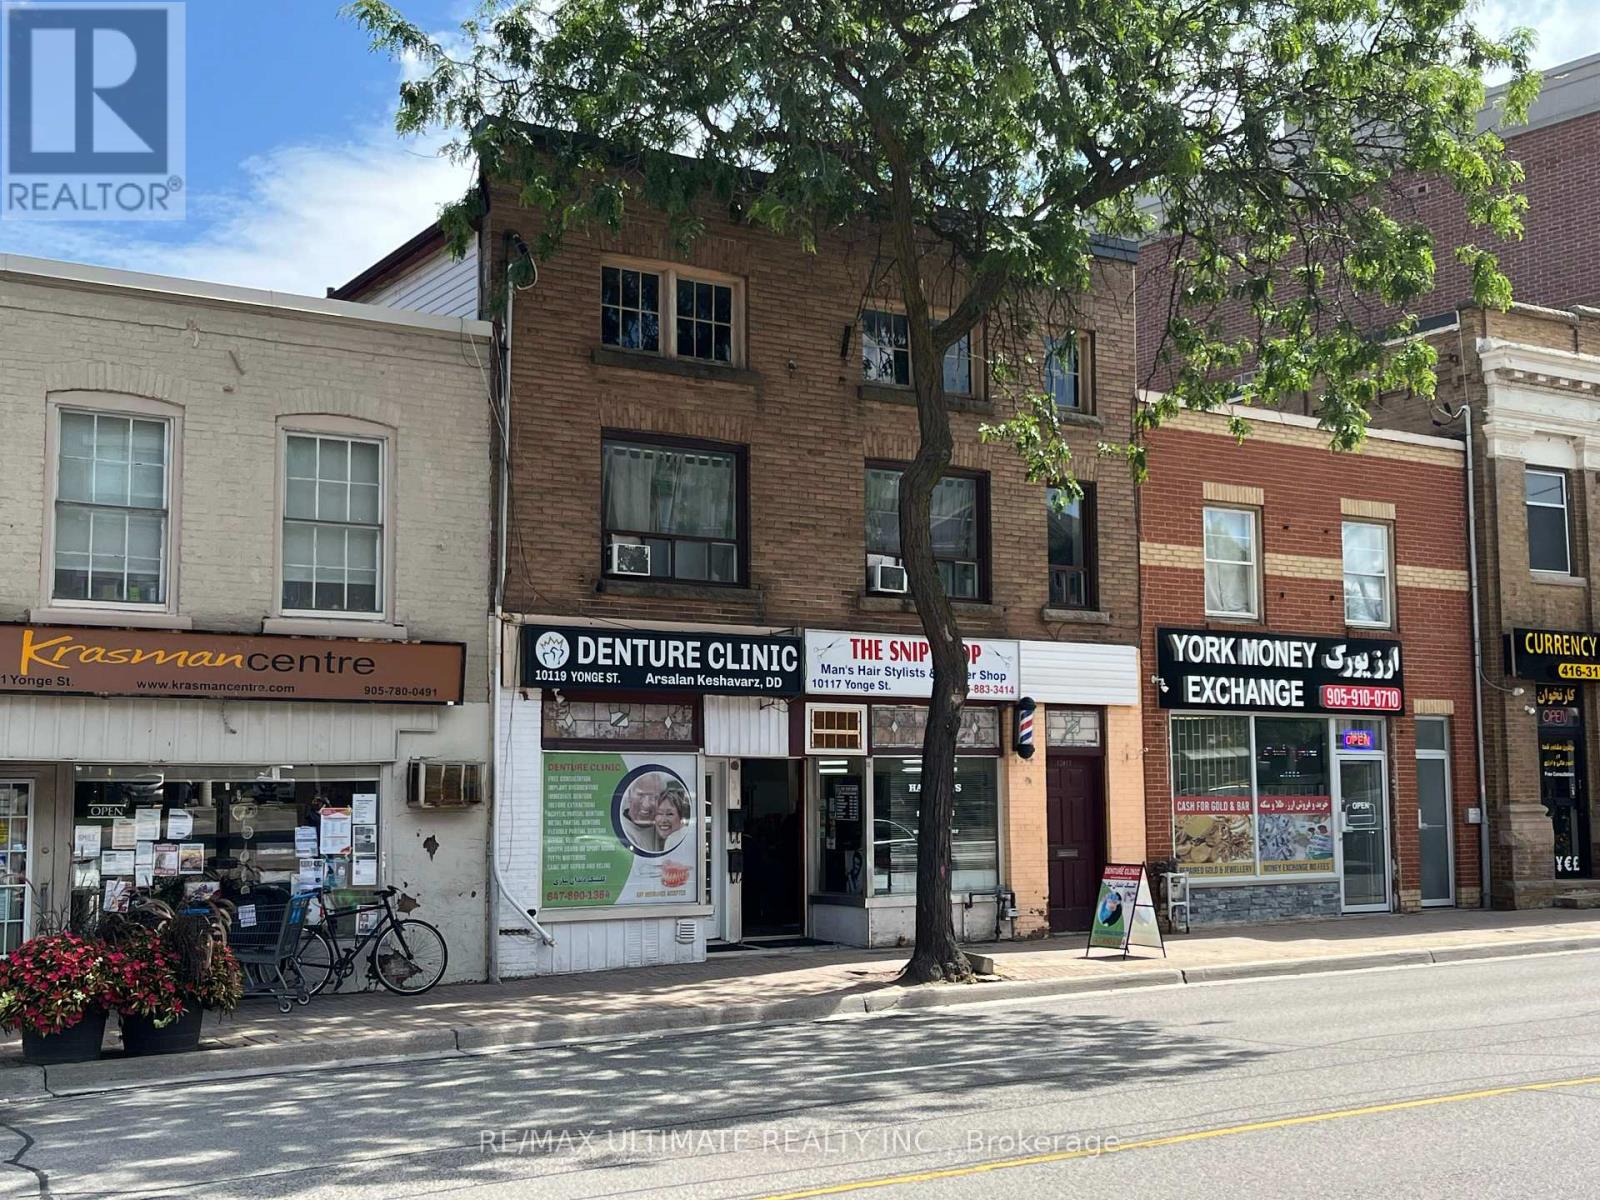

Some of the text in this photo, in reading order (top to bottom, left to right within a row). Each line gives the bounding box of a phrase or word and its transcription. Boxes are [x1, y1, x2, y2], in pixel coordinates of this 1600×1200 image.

[849, 638, 883, 661] THE
[889, 640, 929, 663] SNIP
[1171, 634, 1317, 669] YORK MONEY
[1525, 632, 1597, 657] CURRENCY
[577, 635, 798, 673] DENTURE CLINIC
[535, 669, 621, 684] 10119 YONGE ST.
[821, 663, 854, 675] Man's
[858, 665, 881, 676] Hair
[884, 666, 926, 680] Stylists
[979, 670, 1007, 683] Shop
[1561, 665, 1600, 678] 416-31
[10, 674, 52, 688] Yonge
[56, 676, 75, 687] St.
[136, 679, 295, 694] www.krasmancentre.com
[645, 673, 783, 690] Arsalan Keshavarz, DD
[812, 678, 892, 692] 10117 Yonge St.
[364, 686, 438, 697] 905-780-0491
[1185, 675, 1305, 707] EXCHANGE
[1326, 688, 1400, 708] 905-910-0710
[1543, 709, 1567, 723] OPEN
[1345, 735, 1370, 746] OPEN
[547, 762, 621, 771] DENTURE CLINIC
[90, 807, 123, 816] OPEN
[1177, 800, 1250, 812] CASH FOR GOLD & BAR
